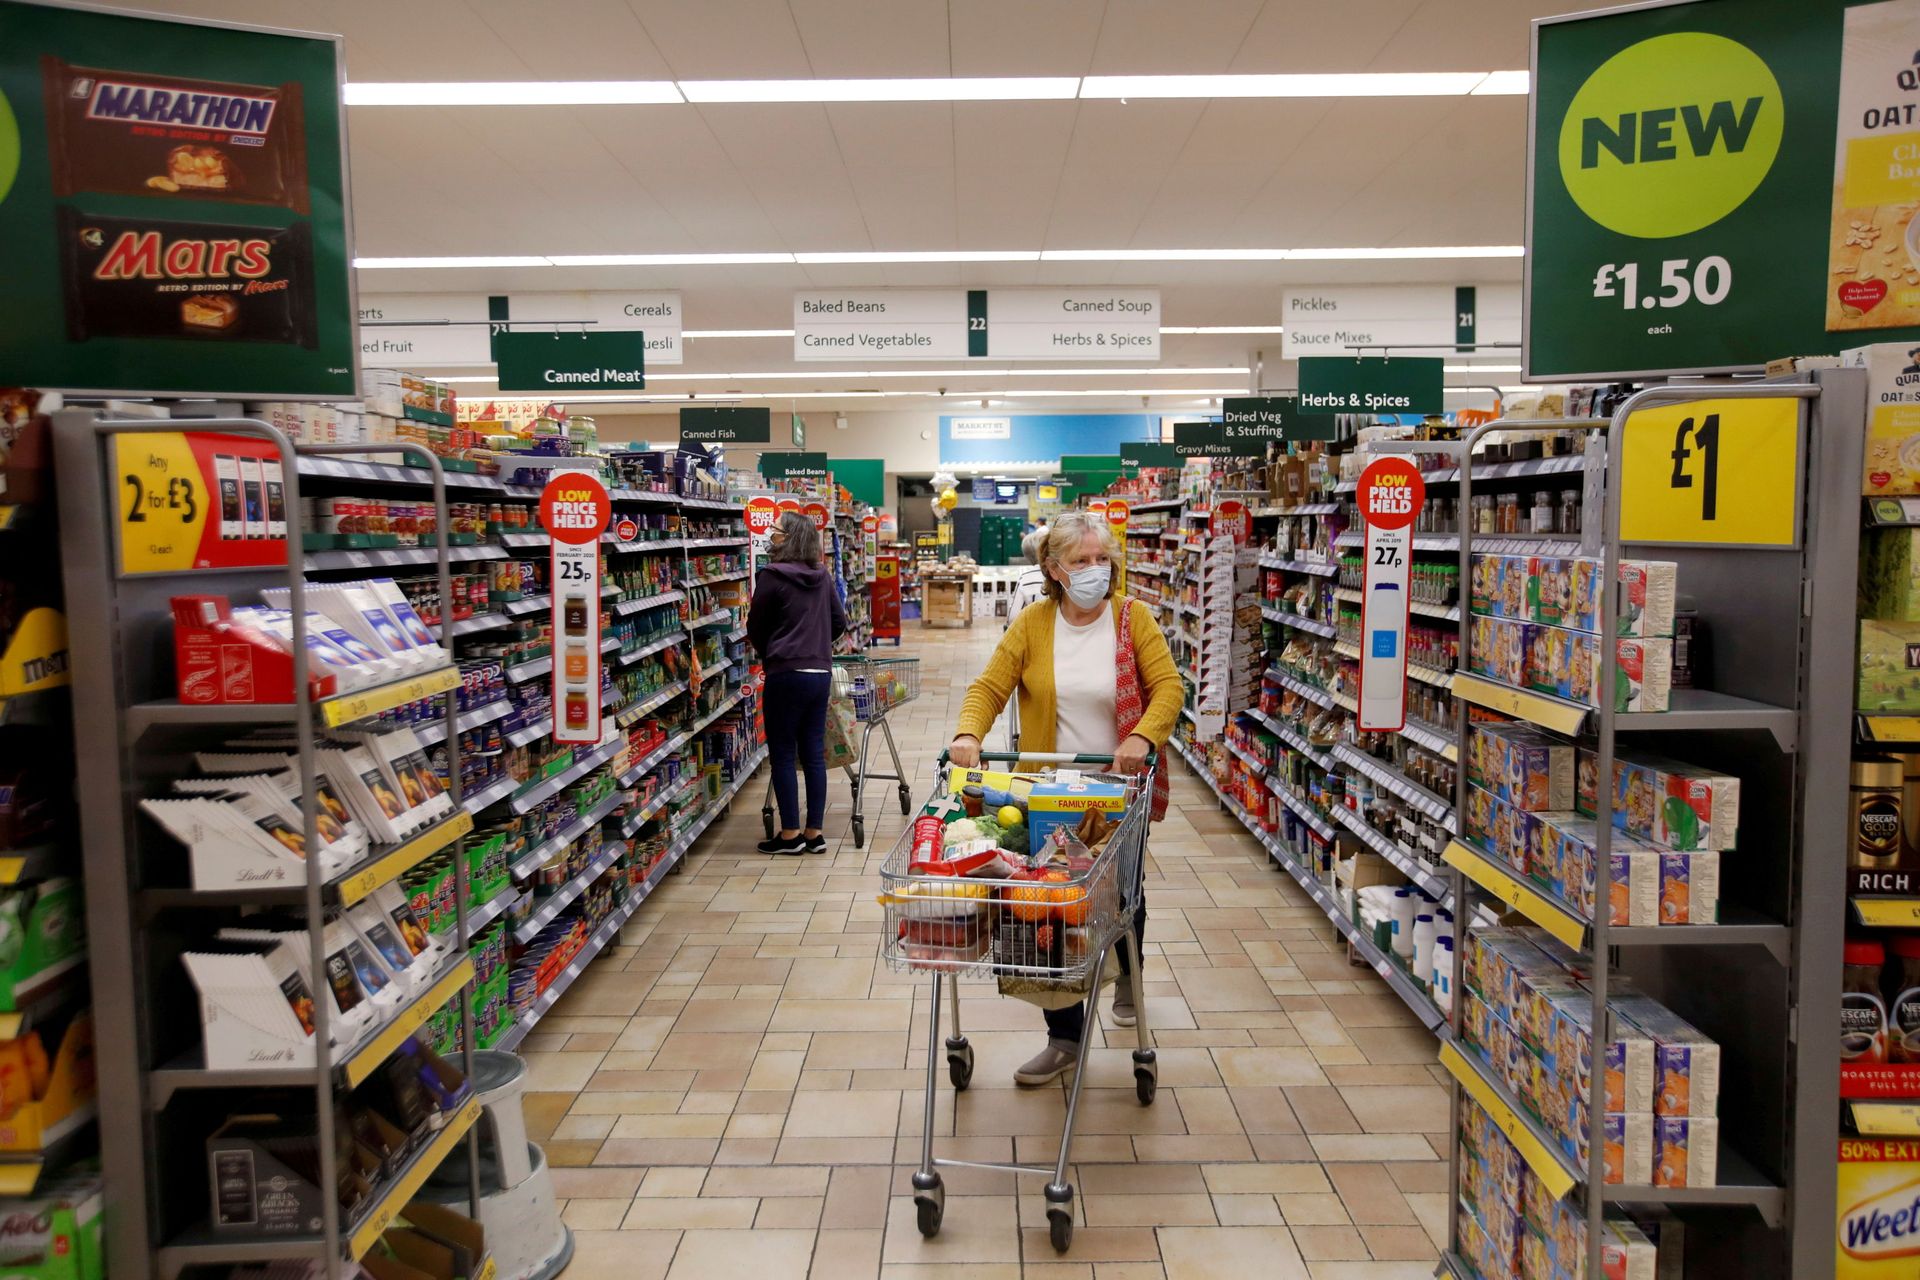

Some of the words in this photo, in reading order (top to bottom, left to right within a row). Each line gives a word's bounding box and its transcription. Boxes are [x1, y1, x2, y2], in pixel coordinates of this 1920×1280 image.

[94, 84, 273, 133] MARATHON
[1863, 104, 1916, 129] OAT
[1581, 96, 1764, 169] NEW
[95, 231, 271, 279] Mars
[157, 284, 189, 292] RETRO
[192, 283, 229, 292] EDITION
[232, 283, 244, 292] BY
[243, 279, 290, 295] Mars
[1592, 255, 1732, 310] £1.50
[624, 303, 672, 316] Cereals
[803, 300, 843, 313] Baked
[847, 300, 885, 313] Beans
[1062, 299, 1114, 313] Canned
[1117, 300, 1152, 315] Soup
[1291, 298, 1337, 311] Pickles
[358, 307, 383, 319] erts
[969, 318, 986, 331] 22
[1458, 314, 1473, 327] 21
[1647, 323, 1672, 335] each
[643, 337, 673, 350] uesli
[803, 333, 854, 347] Canned
[858, 333, 932, 349] Vegetables
[1052, 332, 1093, 346] Herbs
[1096, 333, 1106, 346] &
[1110, 332, 1152, 349] Spices
[1291, 331, 1331, 344] Sauce
[1334, 330, 1372, 345] Mixes
[383, 339, 413, 352] Fruit
[544, 368, 600, 384] Canned
[603, 368, 641, 384] Meat
[1895, 374, 1920, 386] QUA
[1301, 393, 1344, 407] Herbs
[1349, 394, 1361, 407] &
[1364, 393, 1410, 410] Spices
[1881, 392, 1904, 403] OAT
[1225, 411, 1257, 423] Dried
[1260, 411, 1282, 425] Veg
[682, 429, 715, 439] Canned
[717, 429, 736, 439] Fish
[1225, 426, 1235, 437] &
[1237, 425, 1283, 439] Stuffing
[1176, 444, 1203, 456] Gravy
[1204, 444, 1232, 454] Mixes
[149, 455, 168, 472] Any
[1121, 458, 1139, 467] Soup
[1670, 413, 1720, 521] £1
[785, 467, 805, 476] Baked
[806, 467, 826, 476] Beans
[1375, 474, 1407, 487] LOW
[125, 474, 147, 522] 2
[148, 490, 165, 508] for
[168, 477, 198, 523] £3
[558, 490, 592, 501] LOW
[1369, 486, 1412, 500] PRICE
[552, 502, 597, 514] PRICE
[1369, 499, 1412, 514] HELD
[1878, 506, 1898, 515] NEW
[553, 515, 597, 528] HELD
[1374, 546, 1402, 568] 27p
[560, 561, 592, 582] 25p
[1058, 799, 1087, 808] FAMILY
[1087, 800, 1109, 809] PACK
[1864, 823, 1896, 832] GOLD
[236, 869, 274, 883] Lindt
[1858, 873, 1910, 890] RICH
[1842, 1005, 1878, 1019] ESCAFÉ
[248, 1049, 283, 1062] Lindt
[1841, 1071, 1895, 1079] ROASTED
[1870, 1082, 1897, 1090] FULL
[1840, 1141, 1880, 1159] 50%
[1884, 1141, 1920, 1159] EXT
[1847, 1196, 1920, 1248] Weet
